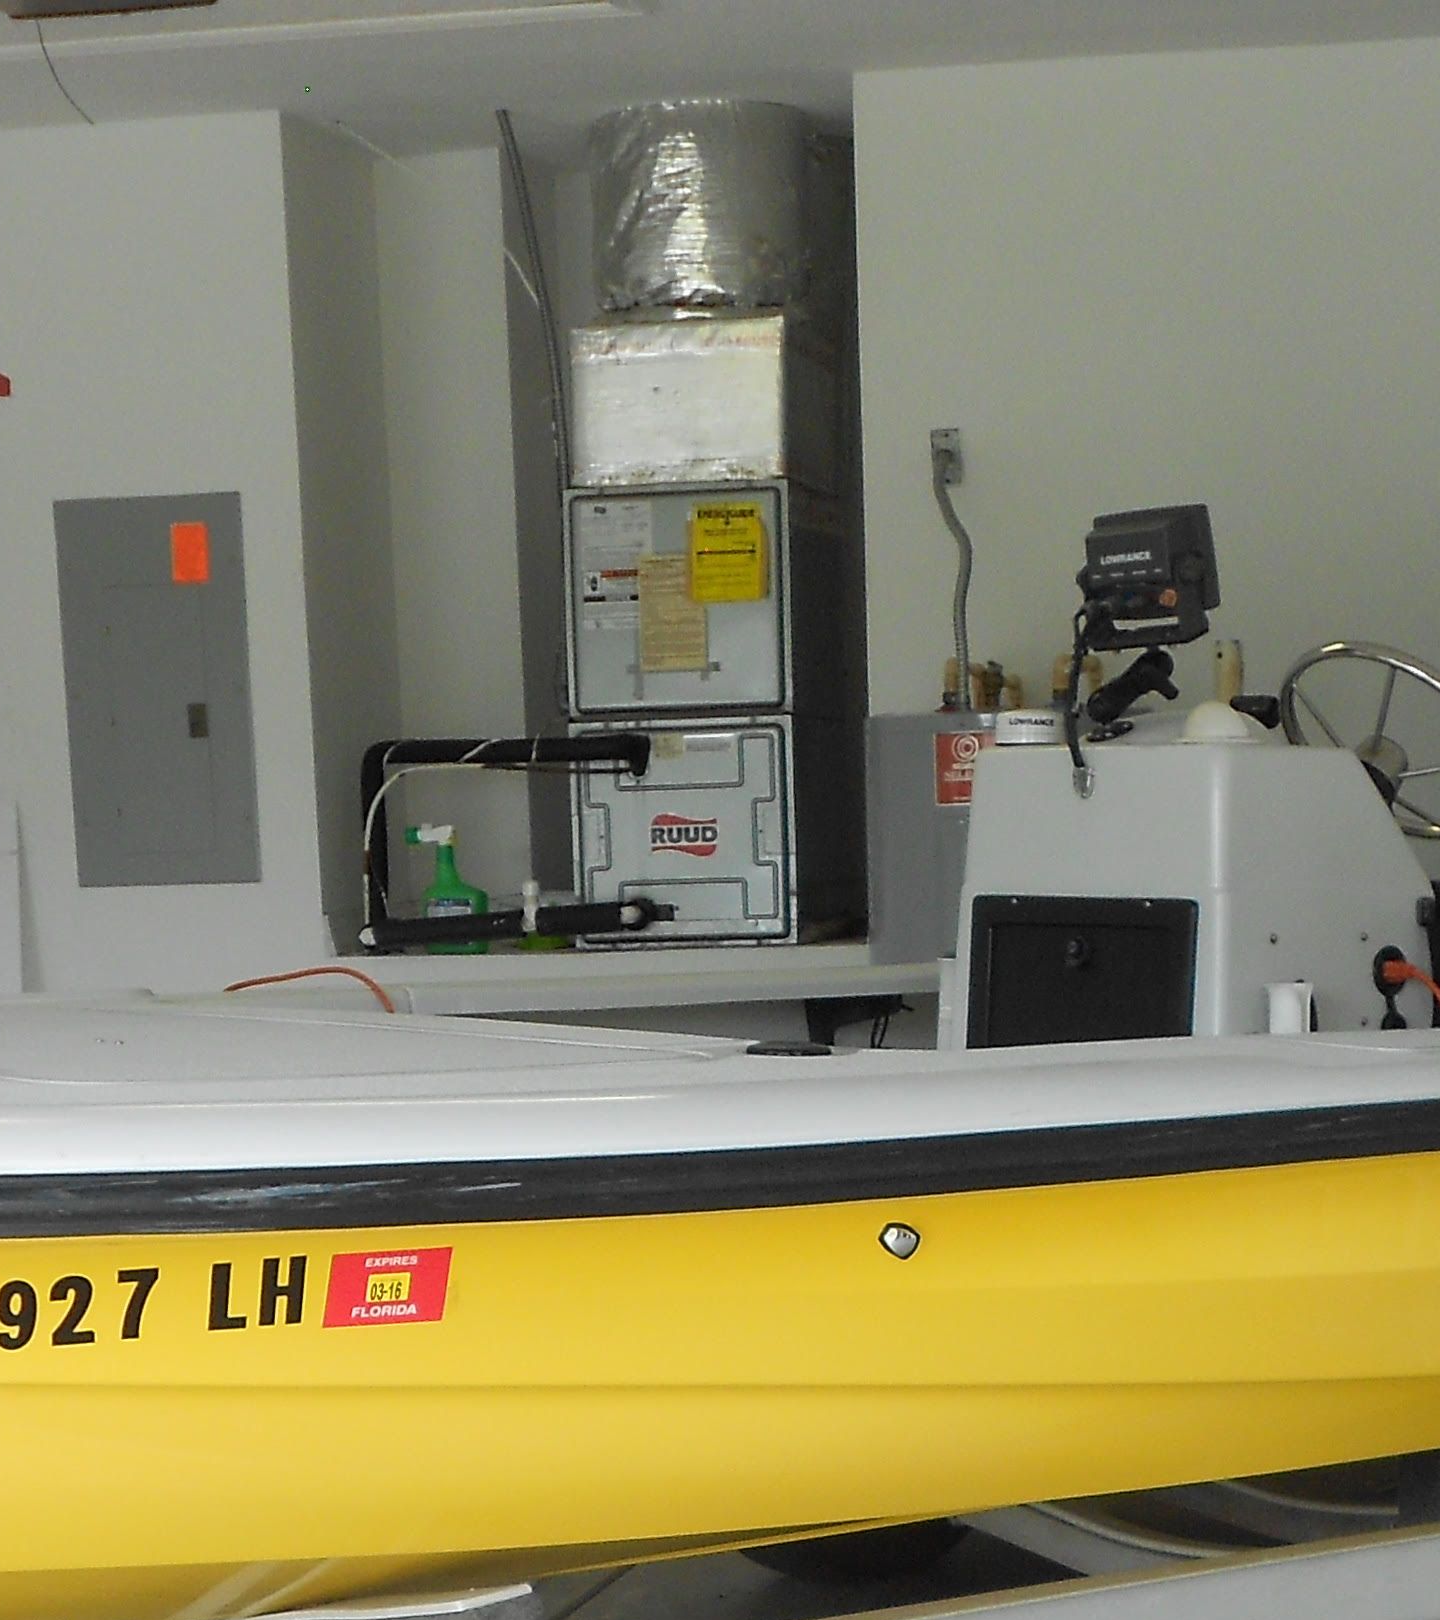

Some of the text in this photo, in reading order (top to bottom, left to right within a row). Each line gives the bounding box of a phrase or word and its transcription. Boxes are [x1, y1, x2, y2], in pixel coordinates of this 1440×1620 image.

[1101, 551, 1152, 566] LOWRANCE
[1009, 718, 1055, 727] LOWRANCE
[651, 826, 718, 844] RUUD
[365, 1256, 418, 1268] EXPIRES
[208, 1255, 308, 1331] LH
[370, 1282, 402, 1301] 03-16
[351, 1304, 417, 1318] FLORIDA
